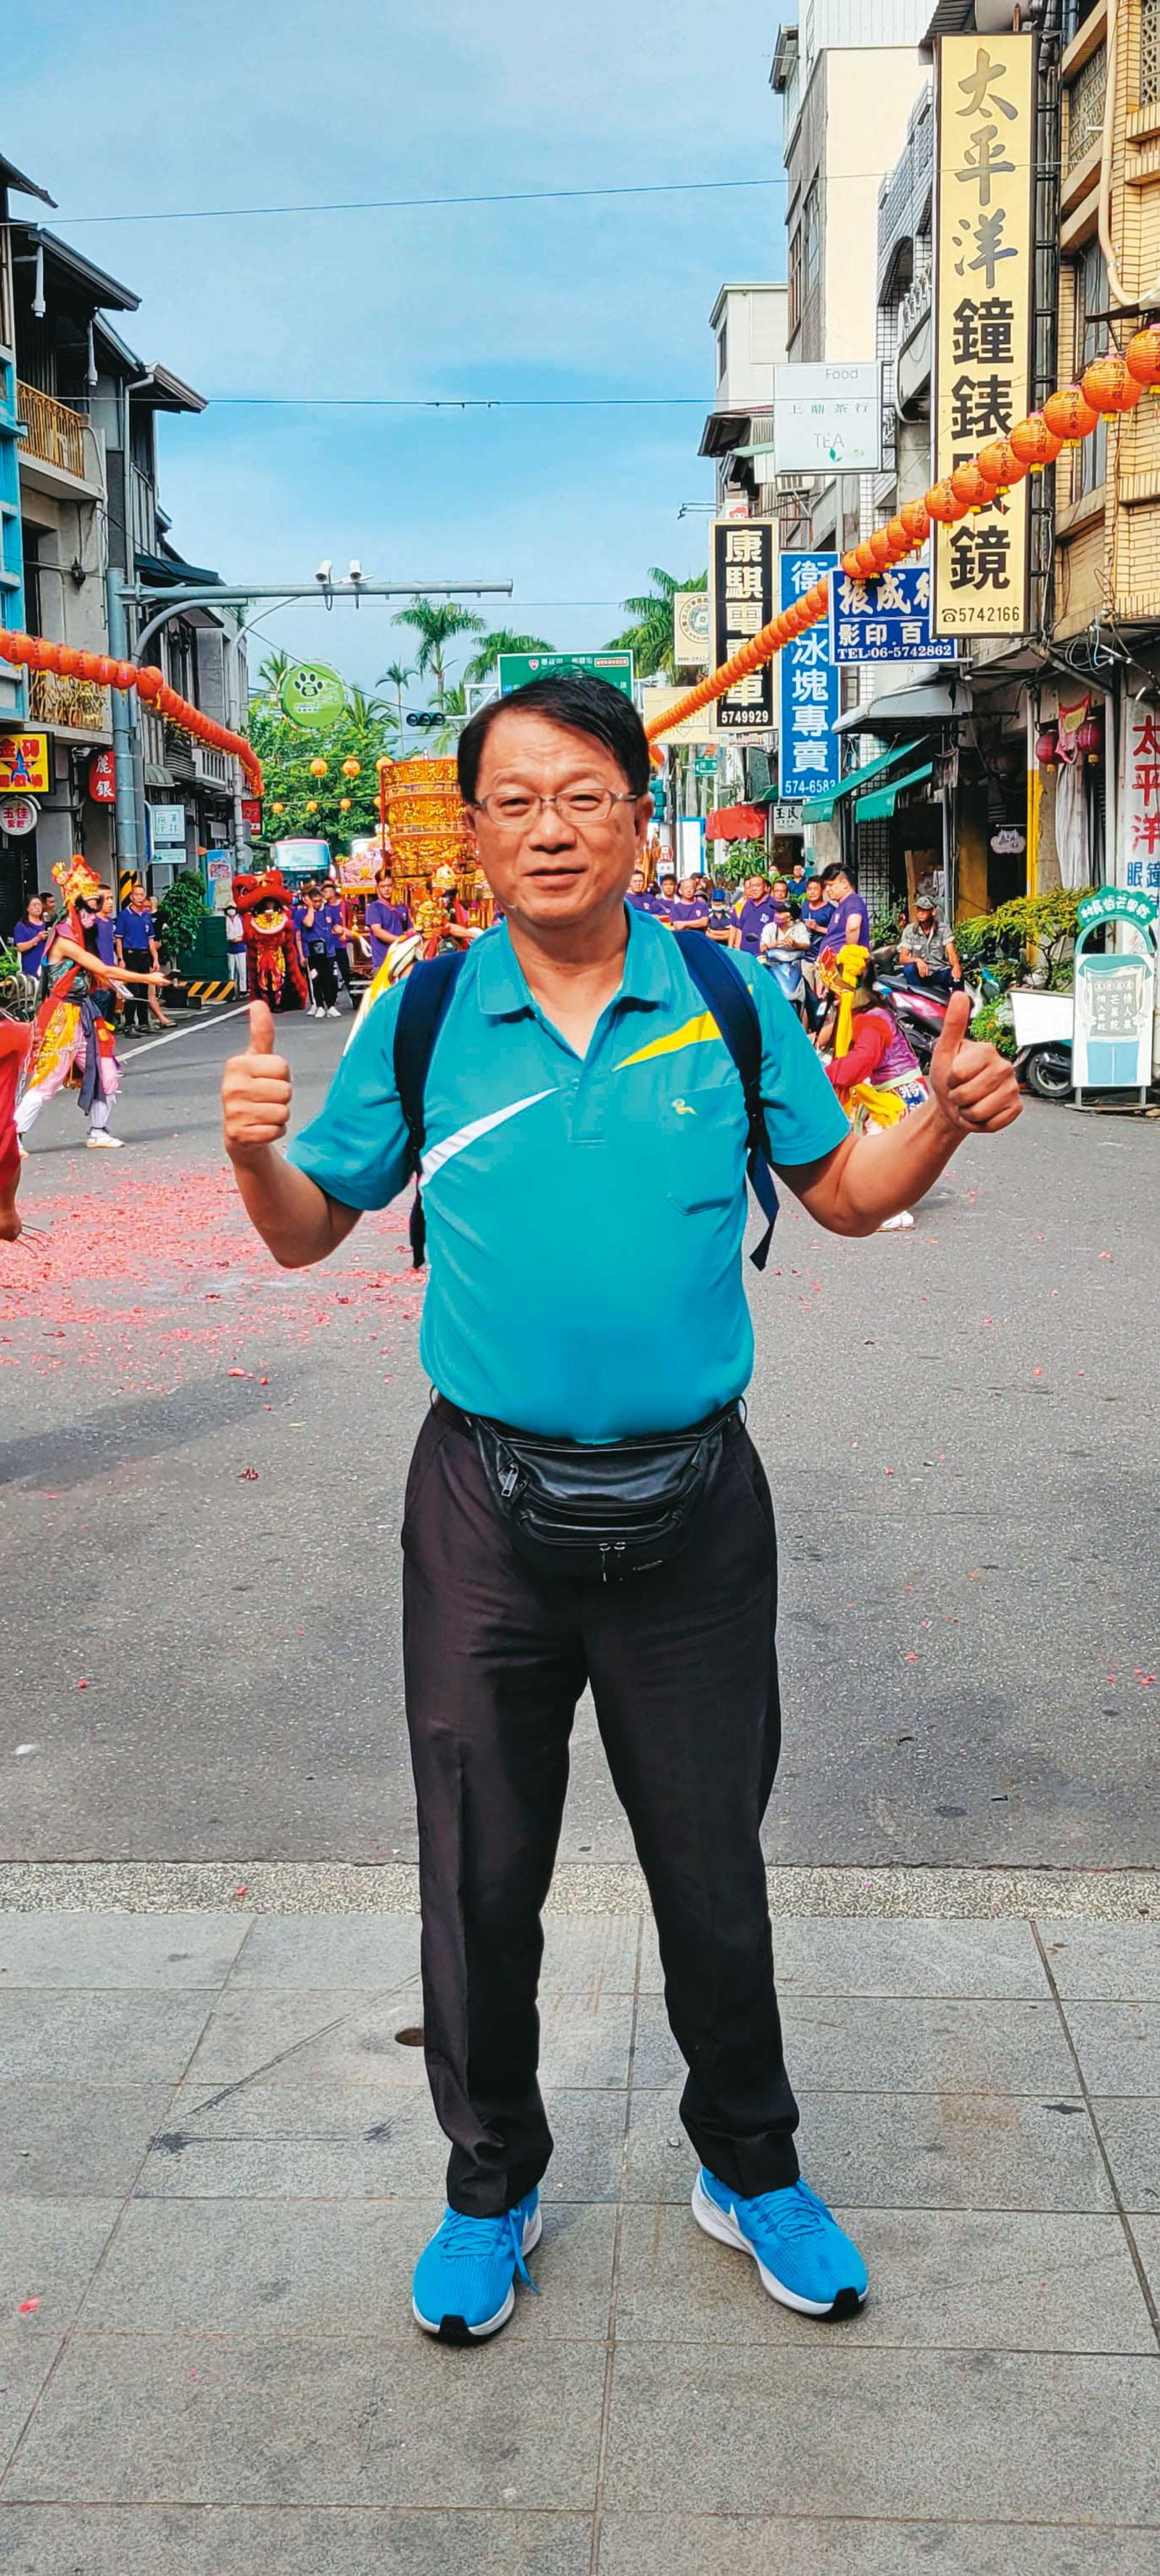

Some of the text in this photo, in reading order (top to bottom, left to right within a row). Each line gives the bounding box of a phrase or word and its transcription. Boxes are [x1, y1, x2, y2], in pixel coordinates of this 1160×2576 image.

[950, 48, 1019, 590] 太平洋鐘錶鏡
[825, 368, 858, 379] Food
[813, 433, 845, 449] TEA
[958, 607, 1020, 622] 5742166
[791, 561, 829, 773] 衛冰塊專賣
[721, 710, 769, 724] 5749929
[1132, 715, 1160, 854] 太平洋
